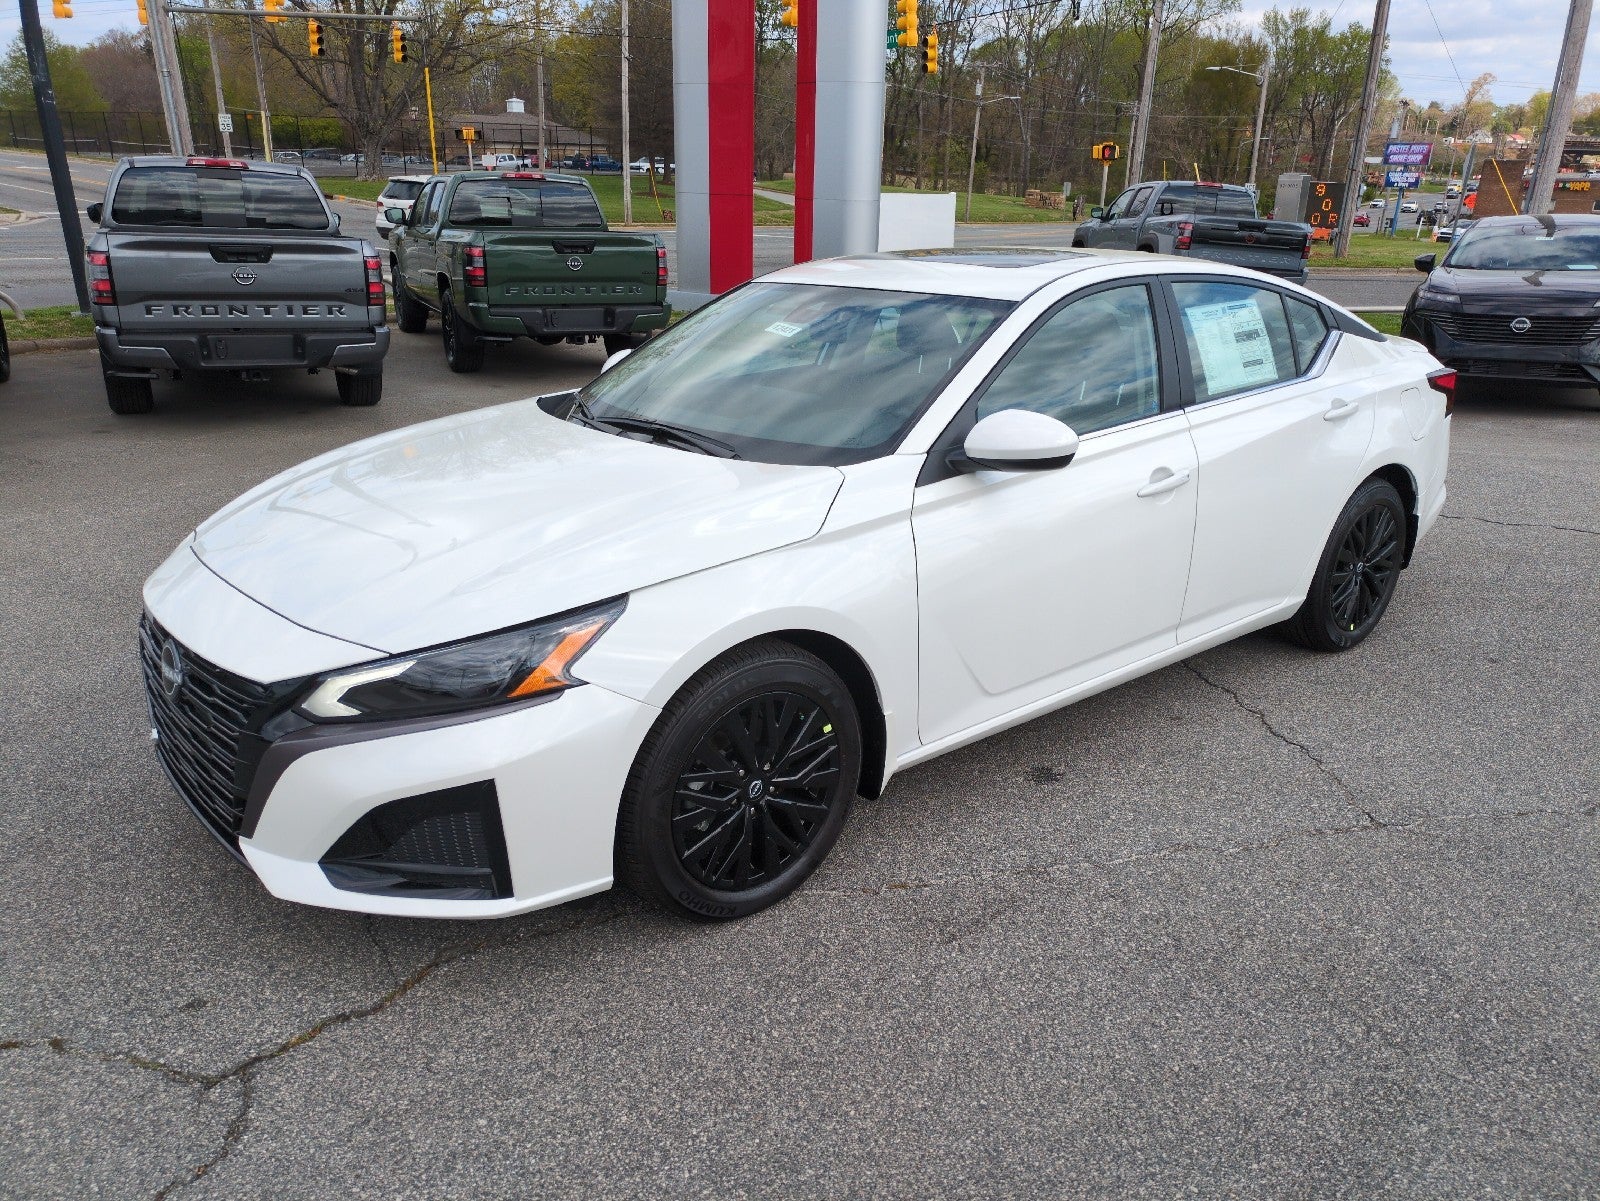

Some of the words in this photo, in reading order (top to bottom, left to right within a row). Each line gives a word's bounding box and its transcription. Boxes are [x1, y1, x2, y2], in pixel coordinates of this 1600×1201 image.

[1569, 181, 1590, 191] VAPE
[504, 285, 643, 296] FRONTIER
[144, 304, 348, 318] FRONTIER
